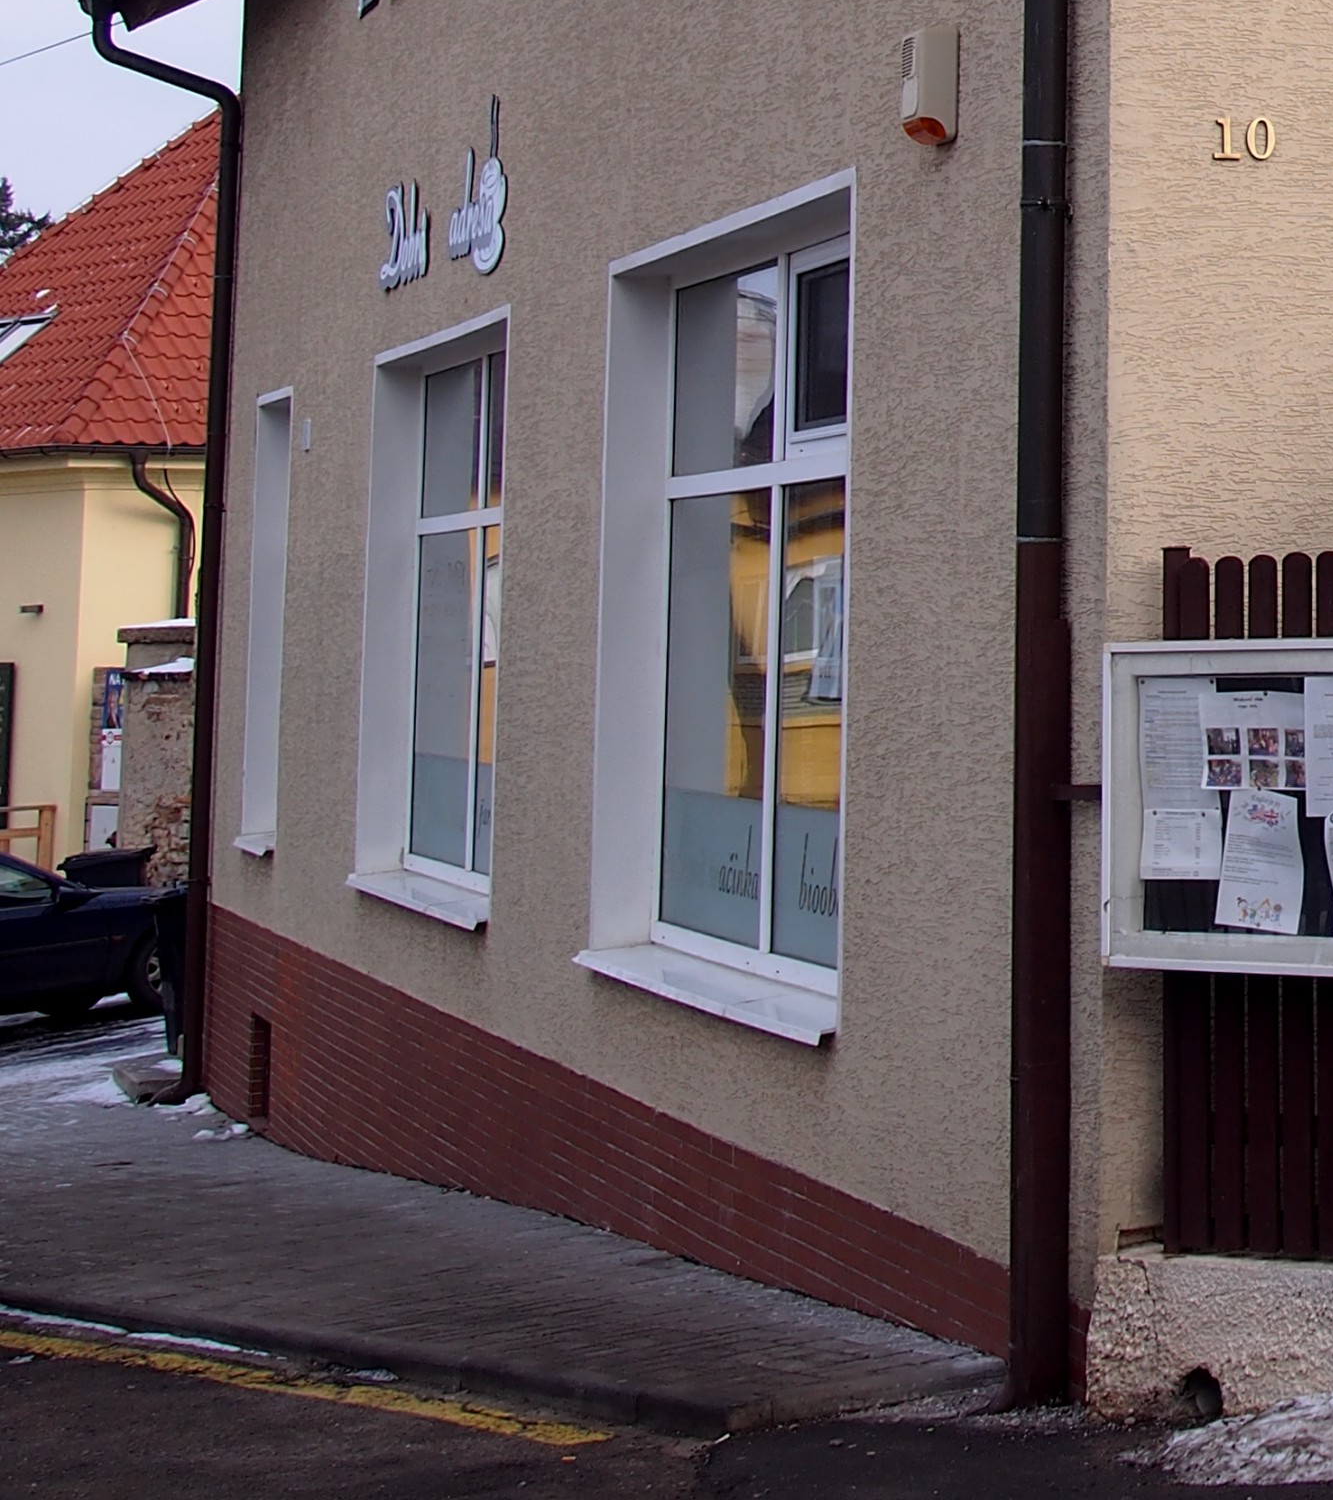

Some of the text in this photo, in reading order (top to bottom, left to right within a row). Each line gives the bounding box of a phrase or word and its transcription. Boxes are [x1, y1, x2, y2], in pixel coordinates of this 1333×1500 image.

[1212, 116, 1276, 161] 10
[718, 825, 838, 917] ačinka bioob
